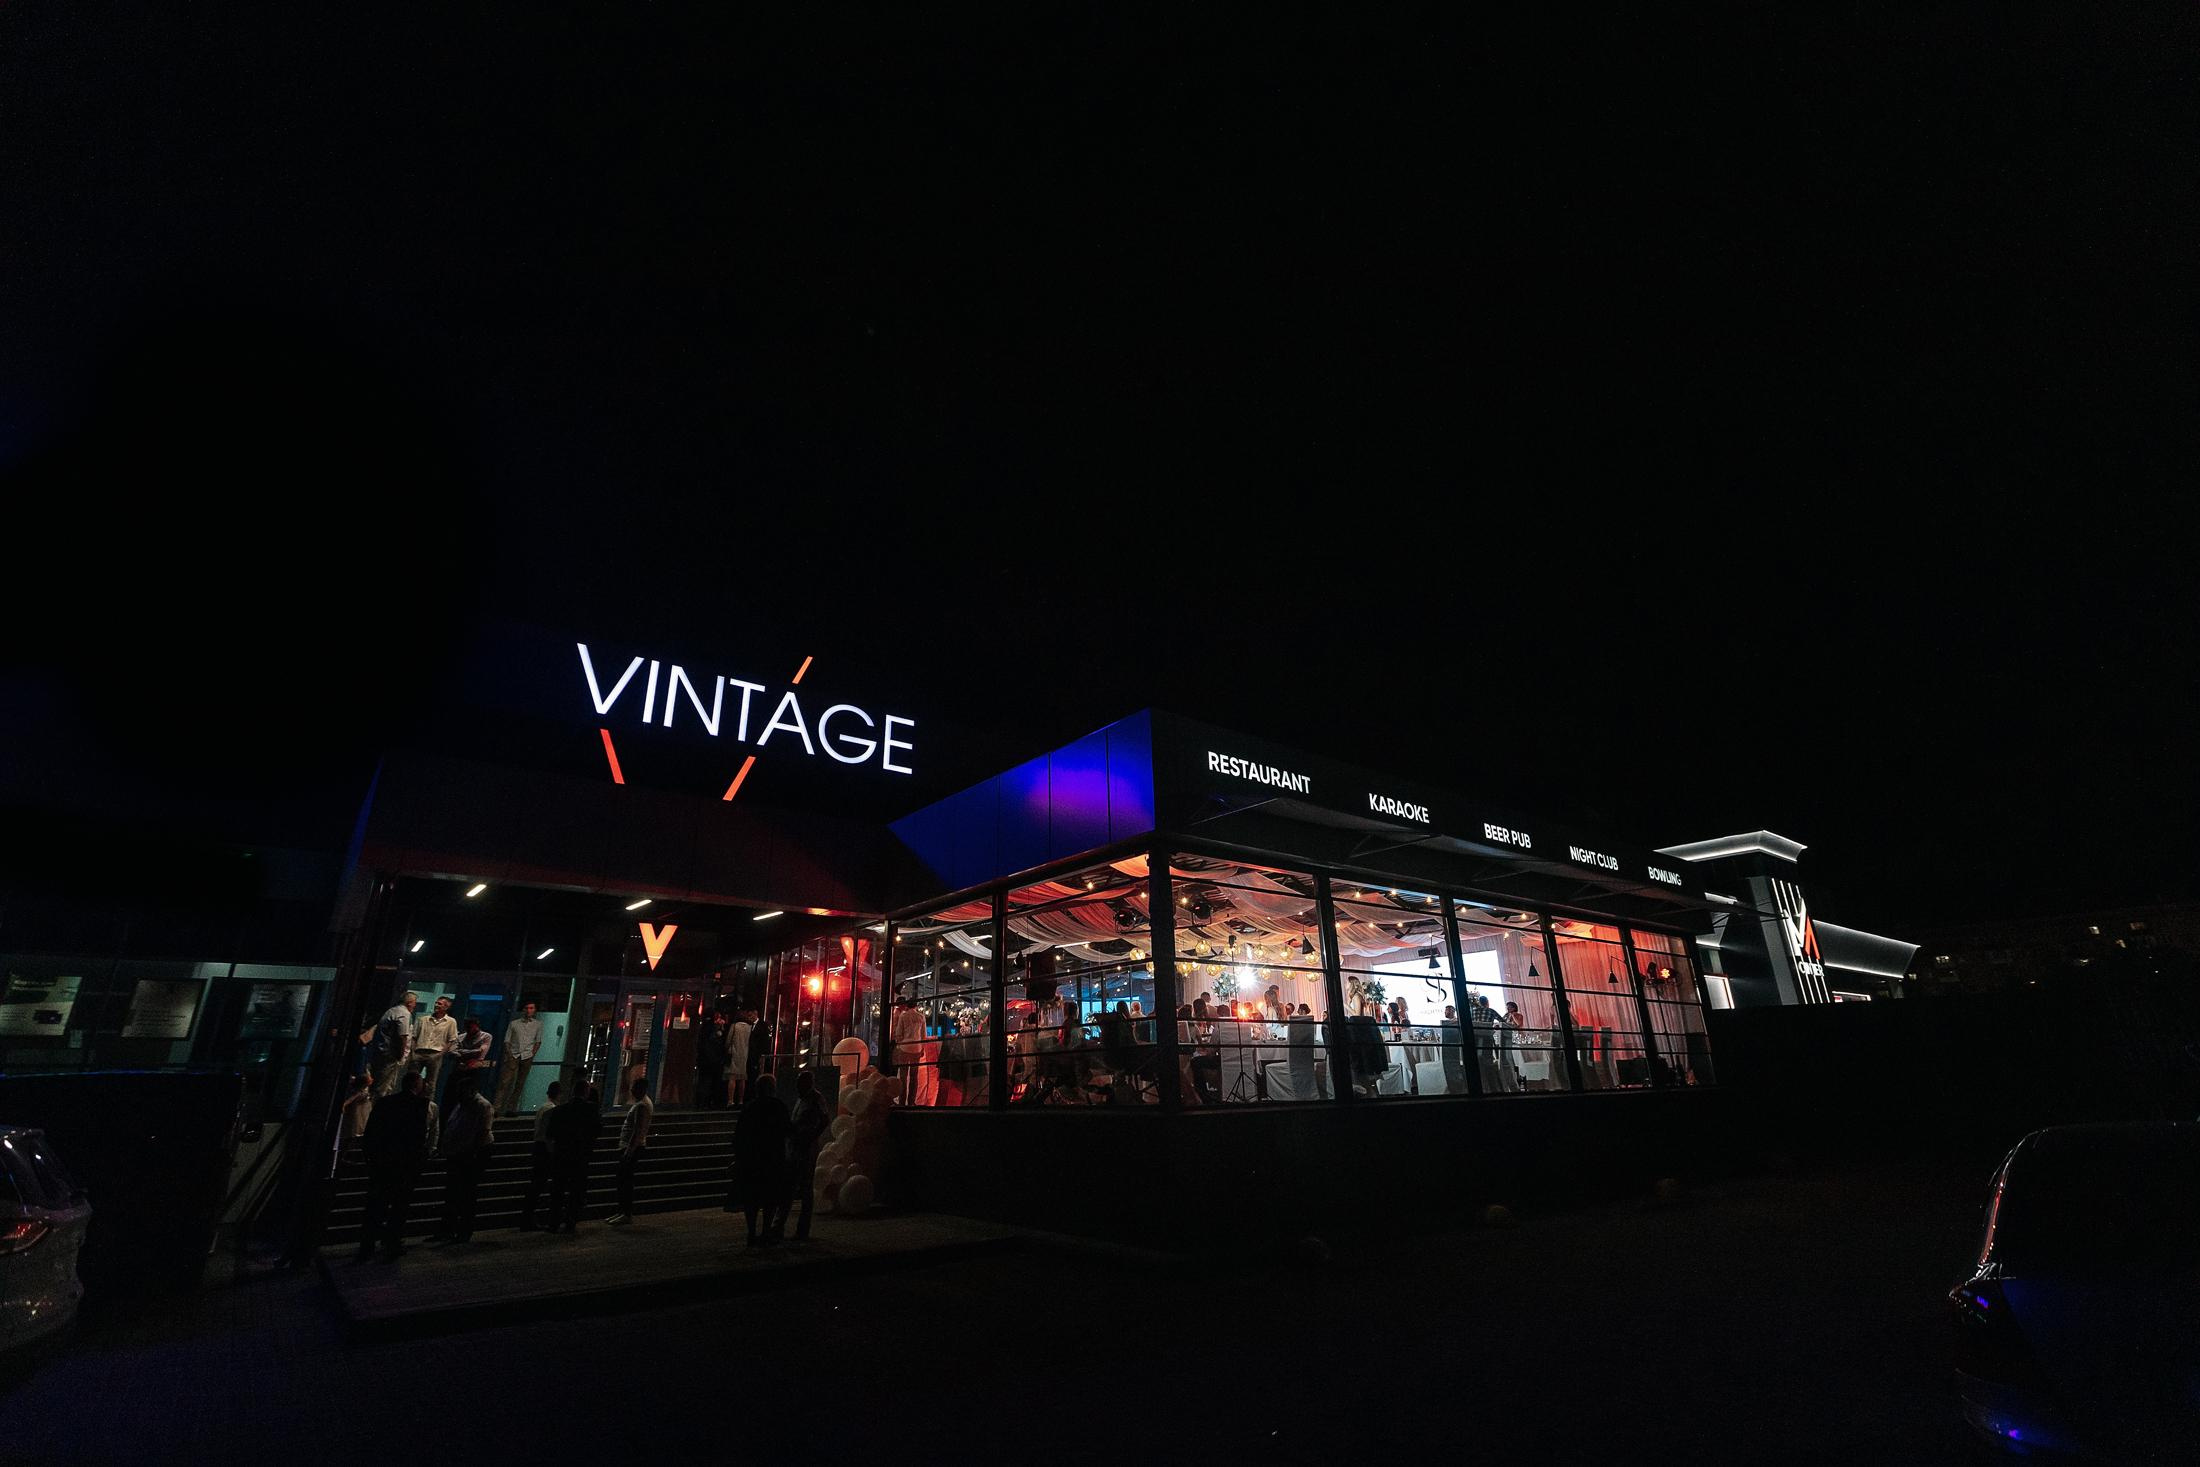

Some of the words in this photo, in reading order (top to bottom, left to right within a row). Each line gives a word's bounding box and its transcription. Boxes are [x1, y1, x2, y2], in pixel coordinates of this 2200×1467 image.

[577, 643, 914, 774] VINTAGE
[1208, 751, 1310, 794] RESTAURANT
[1368, 793, 1430, 823] KARAOKE
[1483, 823, 1510, 844] BEER
[1510, 830, 1532, 848] PUB
[1569, 846, 1597, 865] NIGHT
[1596, 853, 1619, 871] CLUB
[1648, 866, 1682, 886] BOWLING
